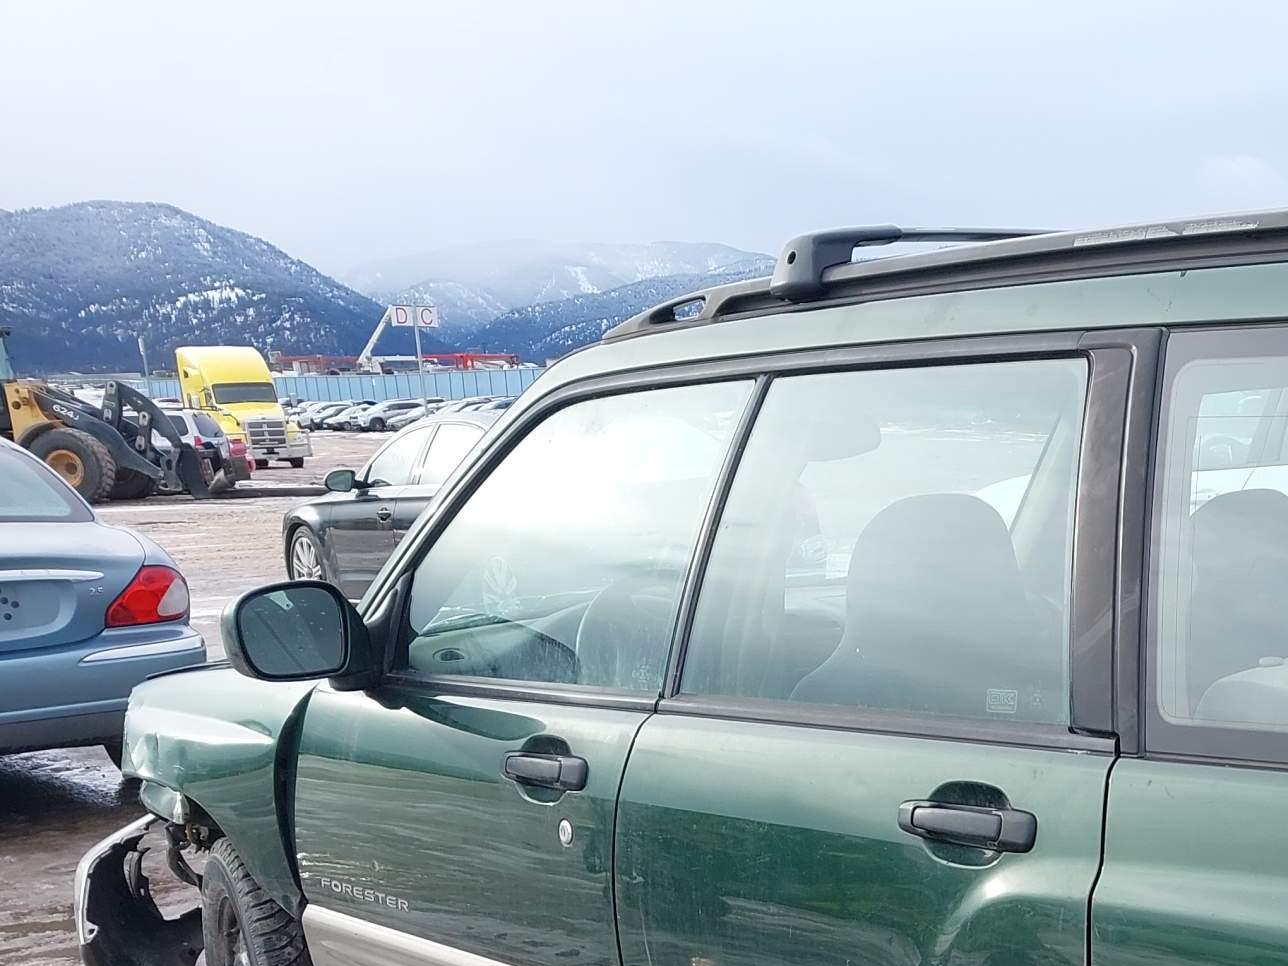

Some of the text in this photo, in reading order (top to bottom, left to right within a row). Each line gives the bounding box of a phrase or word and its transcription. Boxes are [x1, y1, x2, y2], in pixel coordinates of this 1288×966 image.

[396, 307, 433, 325] D C
[52, 404, 80, 421] 624J
[320, 877, 410, 913] FORESTER
